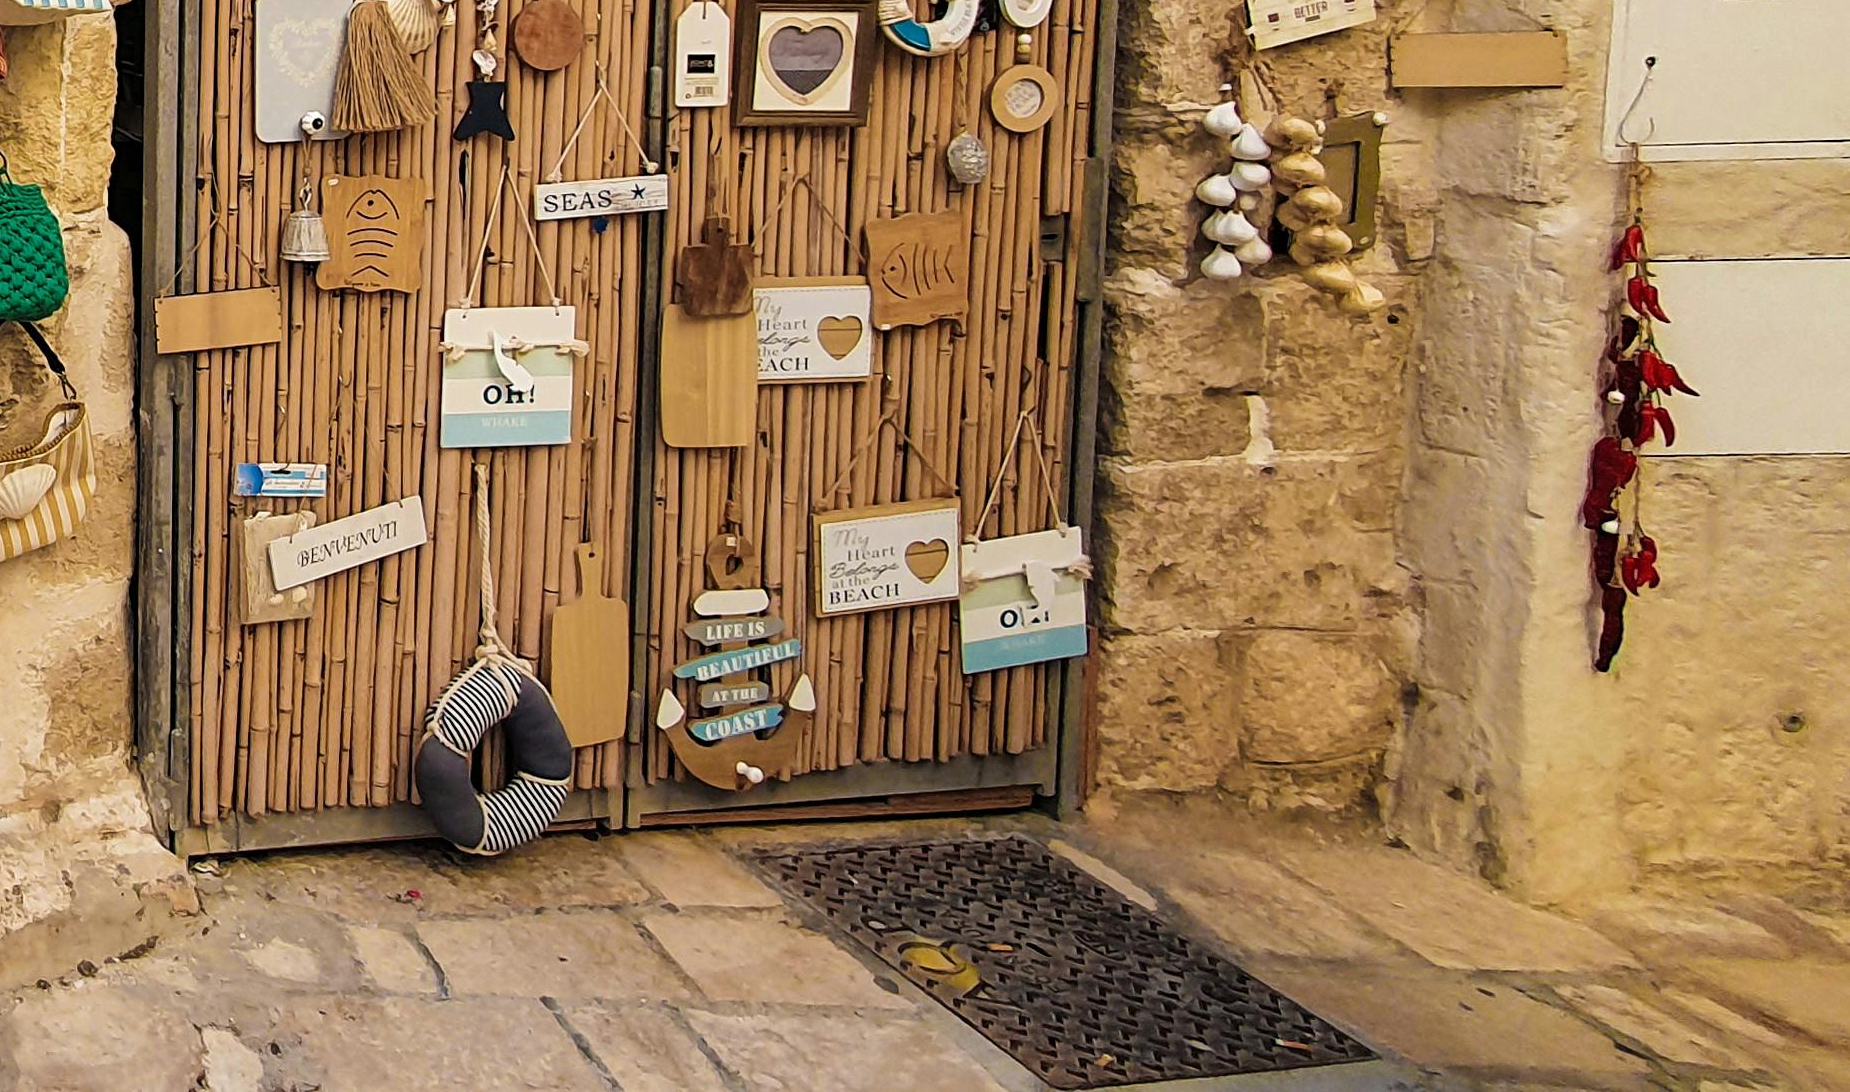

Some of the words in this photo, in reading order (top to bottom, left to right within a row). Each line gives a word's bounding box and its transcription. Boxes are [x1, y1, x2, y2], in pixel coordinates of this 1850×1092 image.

[543, 190, 612, 212] SEAS
[758, 319, 807, 331] Heart
[757, 332, 811, 352] elongs
[297, 520, 397, 568] BENVENUTI
[834, 527, 870, 549] My
[847, 546, 896, 562] Heart
[829, 561, 900, 581] Belongs
[831, 579, 844, 589] at
[848, 575, 870, 587] the
[829, 583, 900, 605] BEACH
[706, 623, 744, 641] LIFE
[748, 621, 766, 636] IS
[697, 642, 796, 681] BEAUTIFUL
[712, 692, 728, 703] AT
[731, 688, 759, 700] THE
[705, 709, 767, 740] COAST
